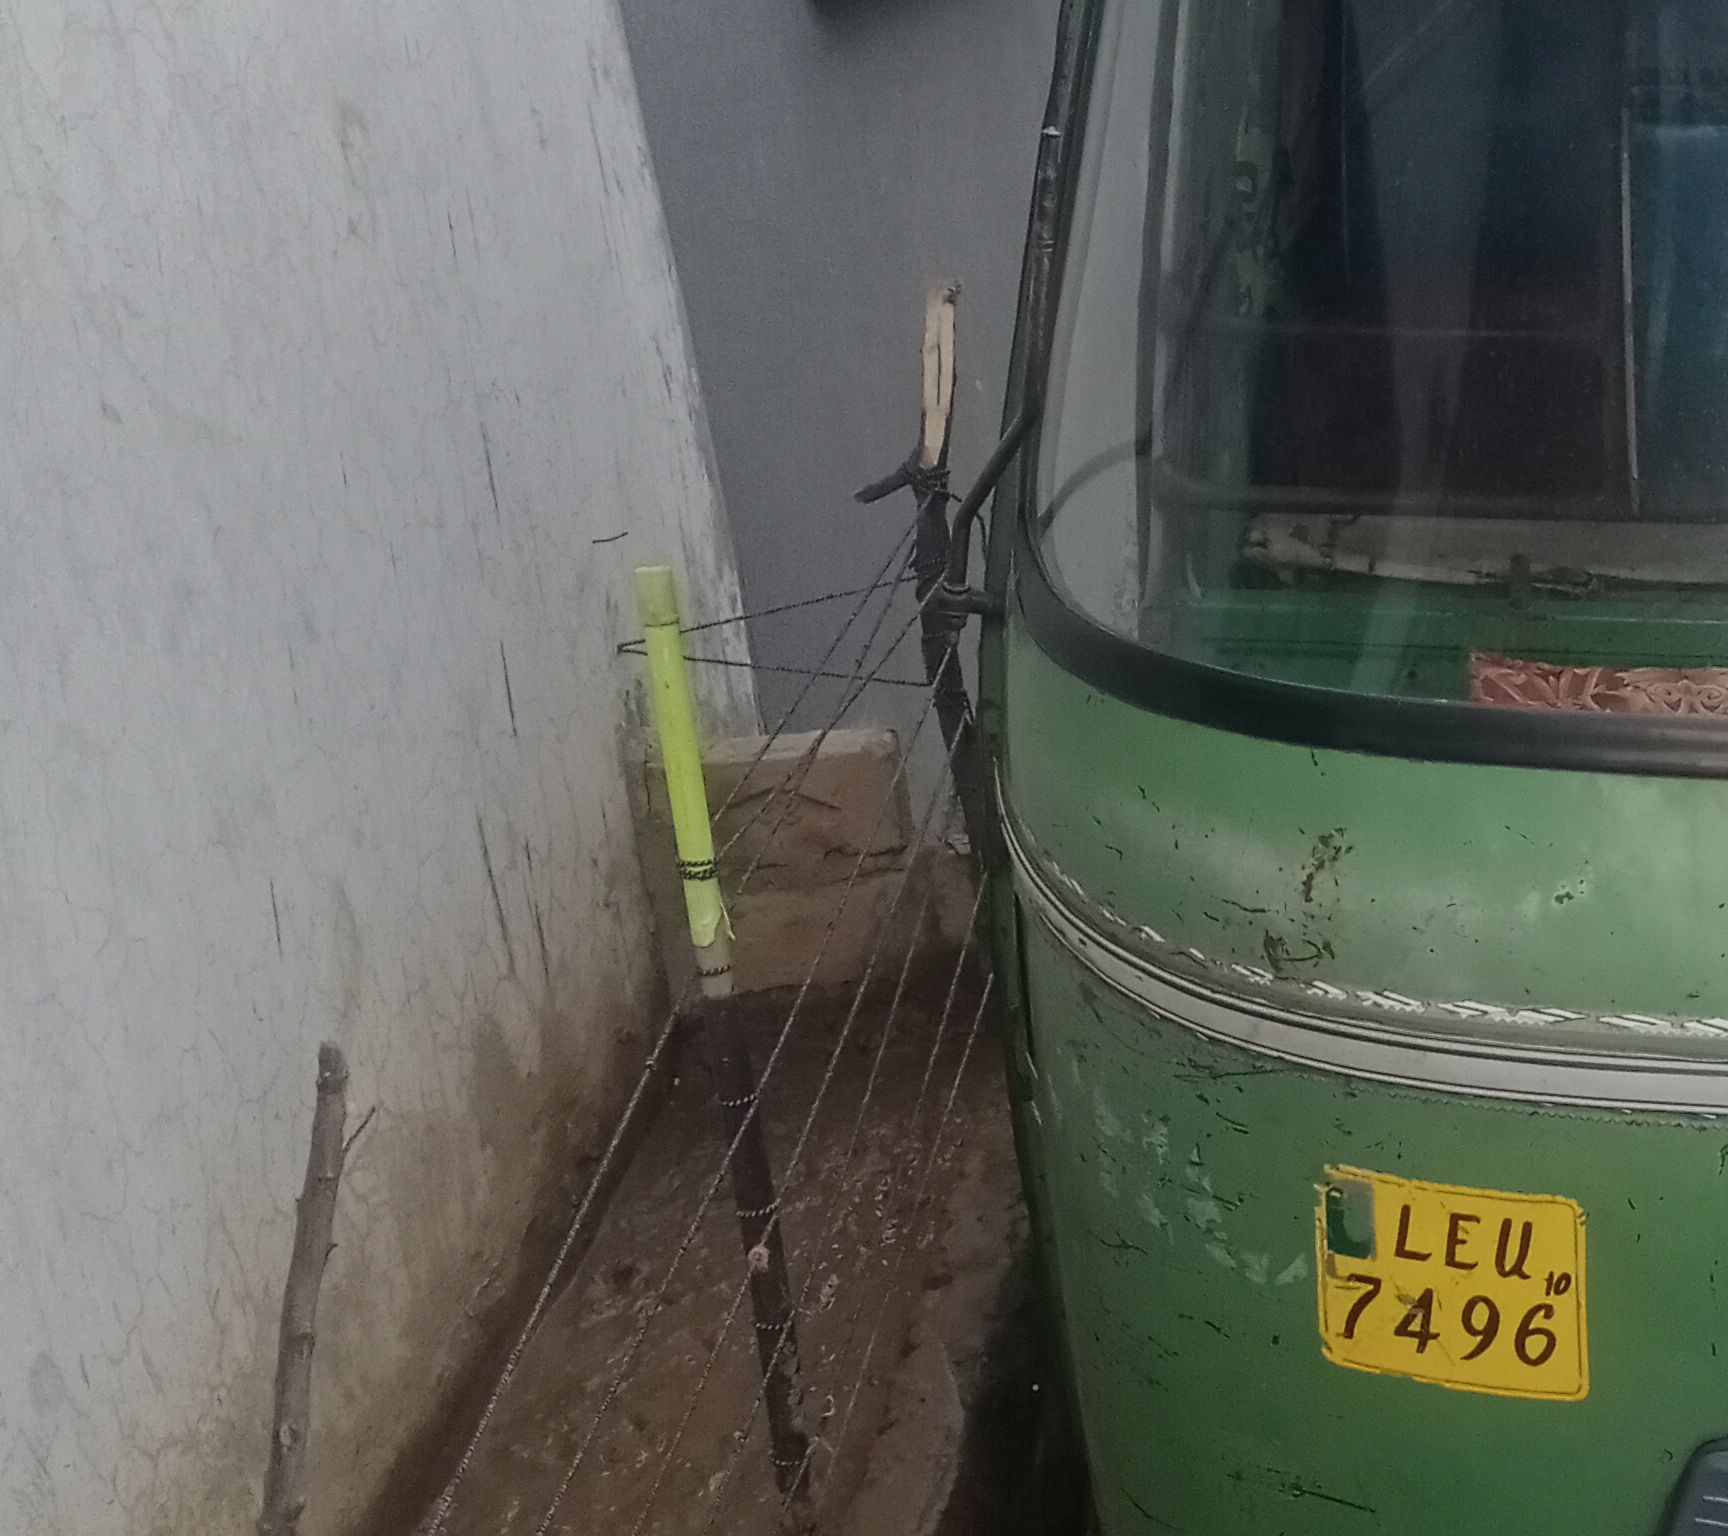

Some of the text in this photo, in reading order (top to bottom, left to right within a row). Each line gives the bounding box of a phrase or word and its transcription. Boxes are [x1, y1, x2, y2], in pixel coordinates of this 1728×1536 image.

[1394, 1204, 1572, 1296] LEU 10
[1343, 1272, 1557, 1366] 7496
